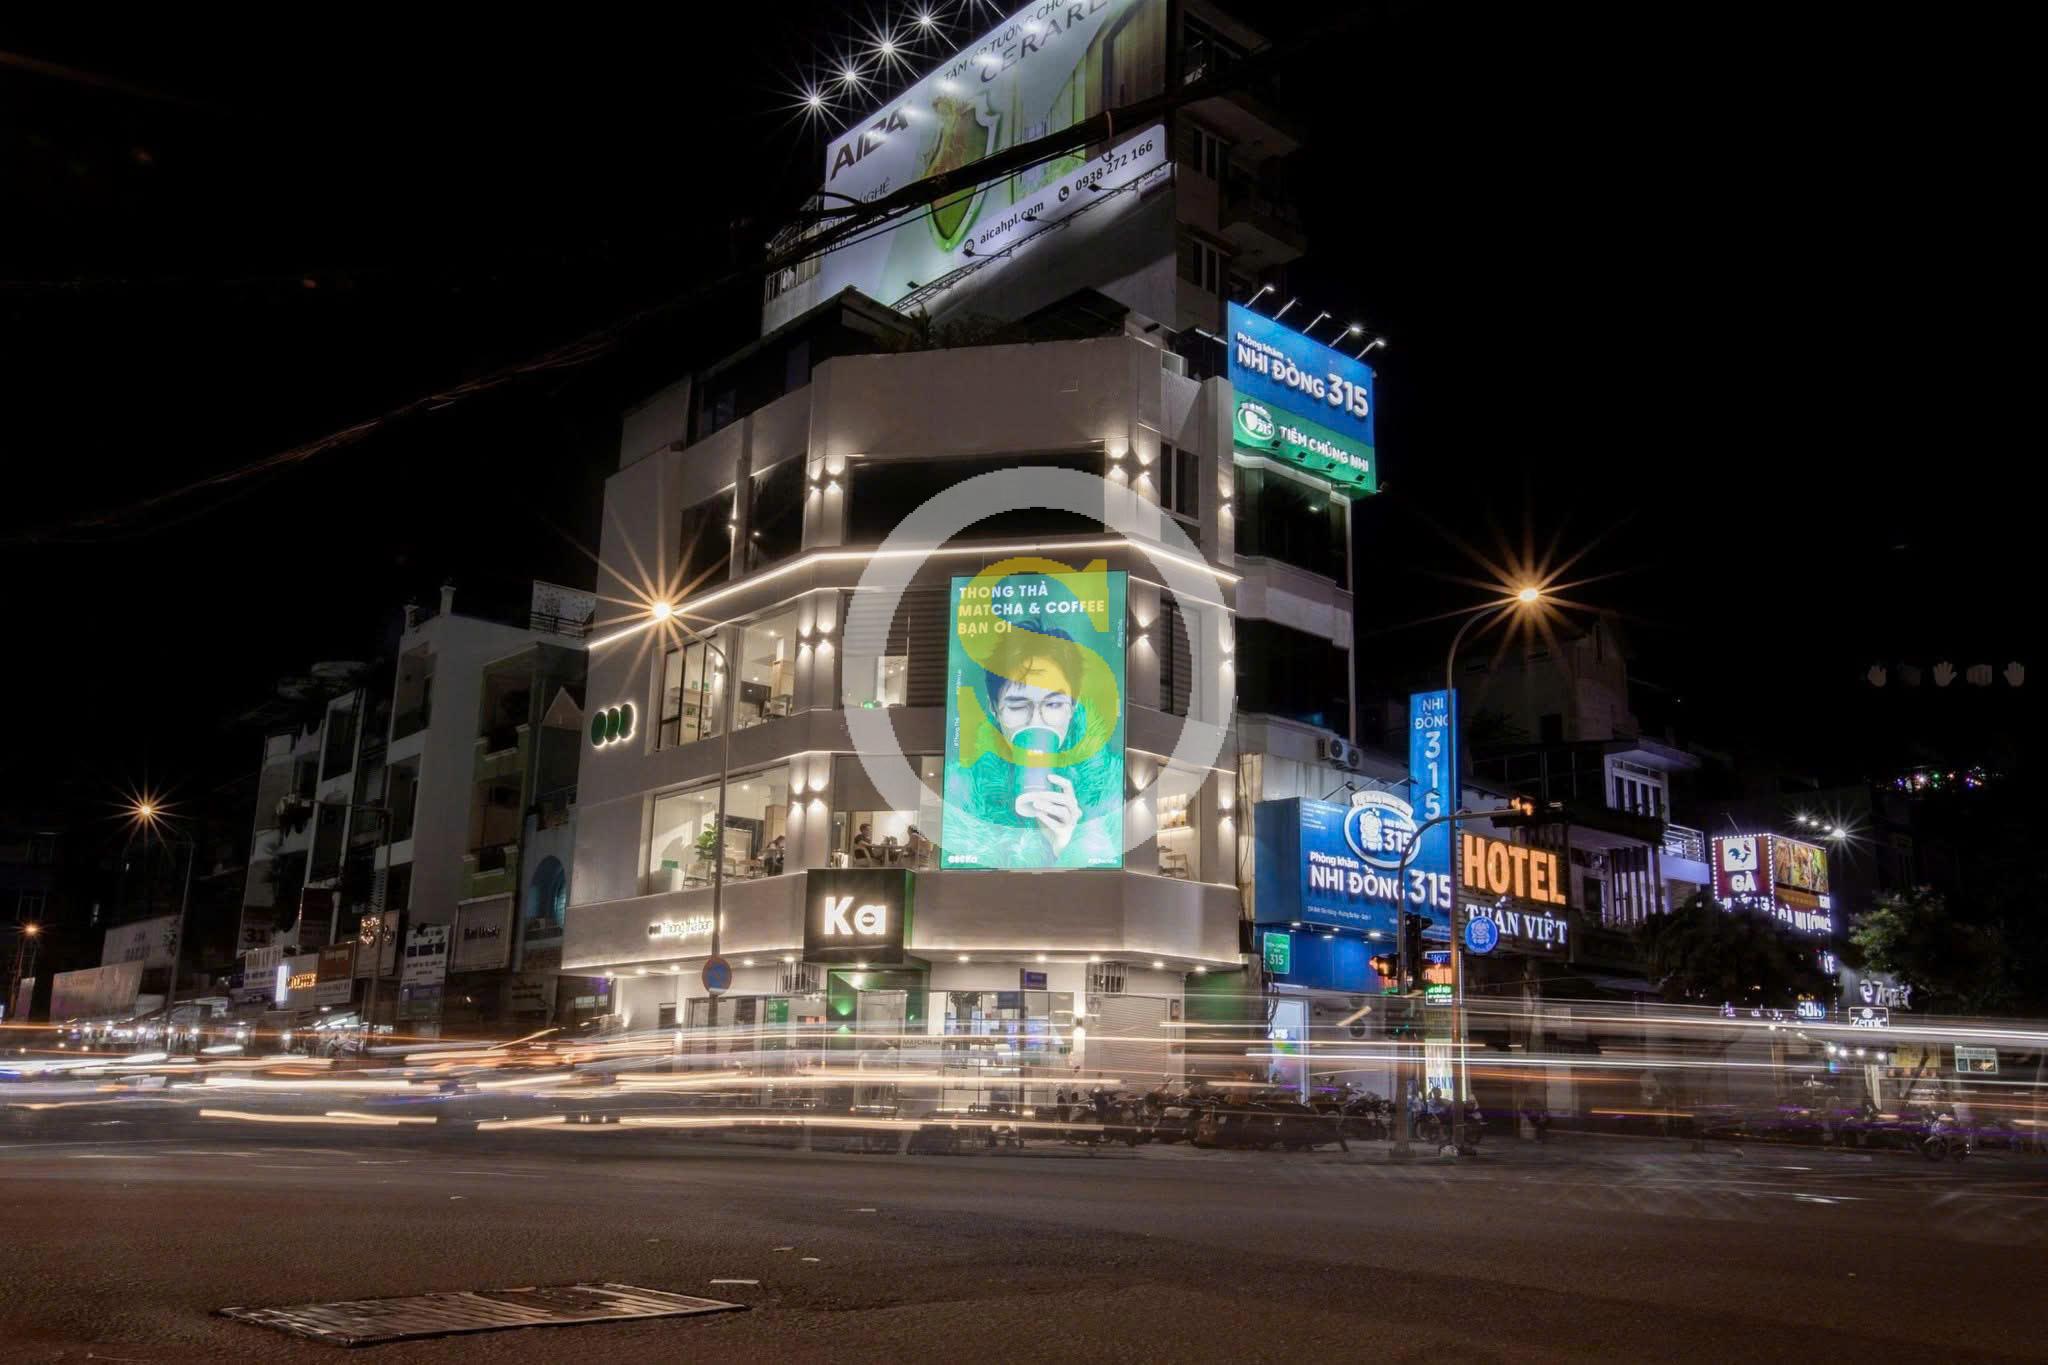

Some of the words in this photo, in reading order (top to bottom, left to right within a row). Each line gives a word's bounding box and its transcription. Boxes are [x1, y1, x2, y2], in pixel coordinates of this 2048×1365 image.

[1075, 168, 1103, 191] 0938
[1106, 156, 1128, 174] 272
[1131, 140, 1153, 161] 166
[1237, 343, 1269, 374] NHI
[1271, 357, 1325, 399] ĐỒNG
[1326, 372, 1369, 418] 315
[959, 585, 1015, 600] THONG
[958, 602, 1024, 617] MATCHA
[1028, 602, 1041, 615] &
[1045, 600, 1104, 614] COFFEE
[957, 622, 988, 638] BẠN
[1422, 697, 1444, 712] NHI
[1309, 851, 1336, 867] Phòng
[1463, 834, 1567, 905] HOTEL
[1311, 864, 1344, 892] NHI
[1349, 864, 1405, 900] ĐỒNG
[1409, 869, 1452, 909] 315
[1731, 870, 1757, 892] GÀ
[824, 896, 887, 935] Ka
[1523, 911, 1568, 950] VIỆT
[1269, 953, 1284, 966] 315
